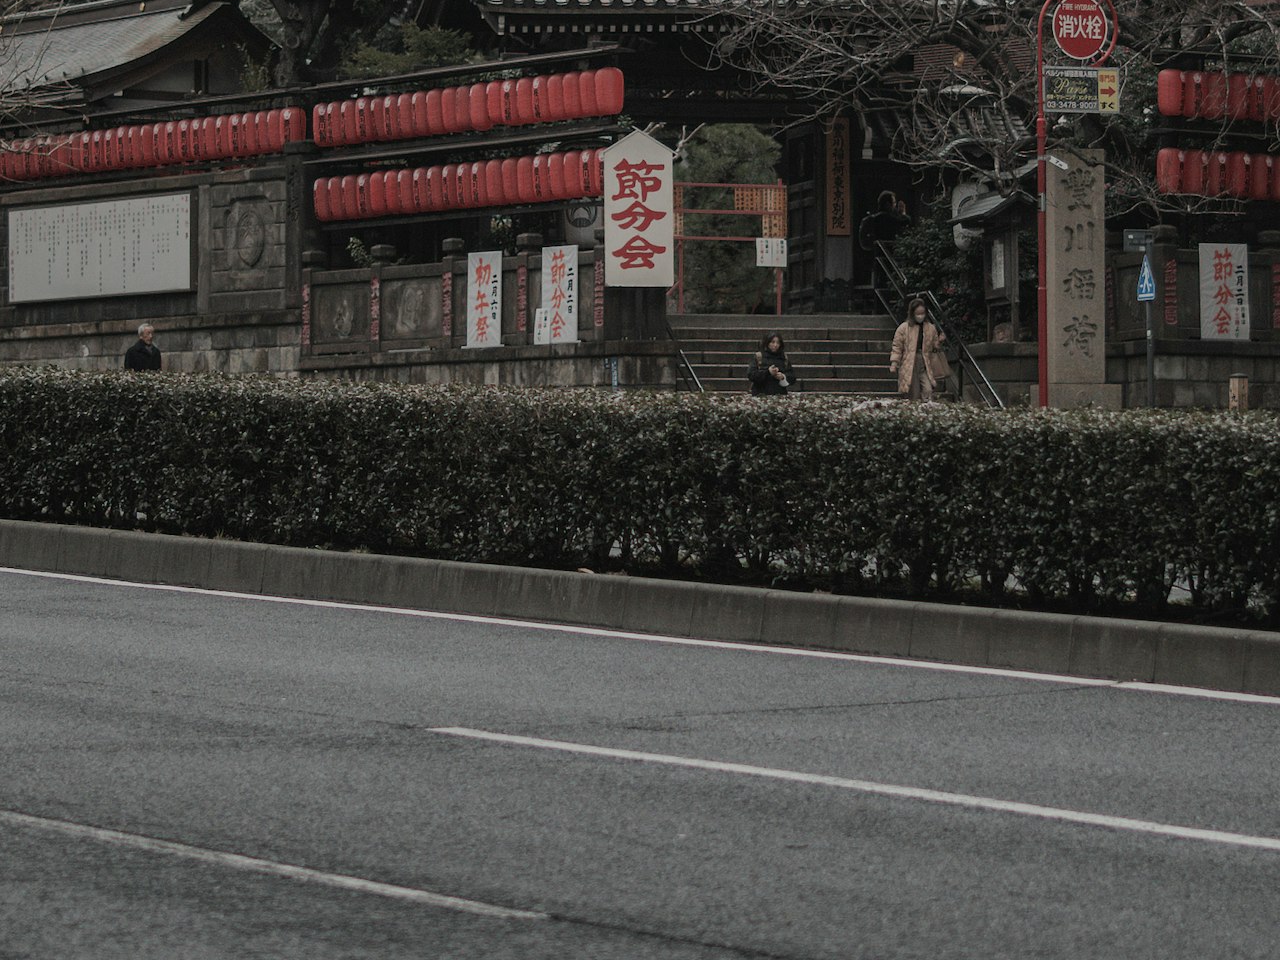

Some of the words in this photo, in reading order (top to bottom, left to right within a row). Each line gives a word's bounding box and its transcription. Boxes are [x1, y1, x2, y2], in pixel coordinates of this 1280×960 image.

[1058, 14, 1103, 39] 消火栓
[1074, 3, 1097, 11] HYDRANT
[611, 158, 667, 269] 節分会
[475, 258, 491, 342] 初午祭
[550, 250, 565, 338] 節分会
[566, 267, 574, 314] 二月二日
[1213, 248, 1234, 335] 節分会
[1234, 265, 1245, 306] 二月二日
